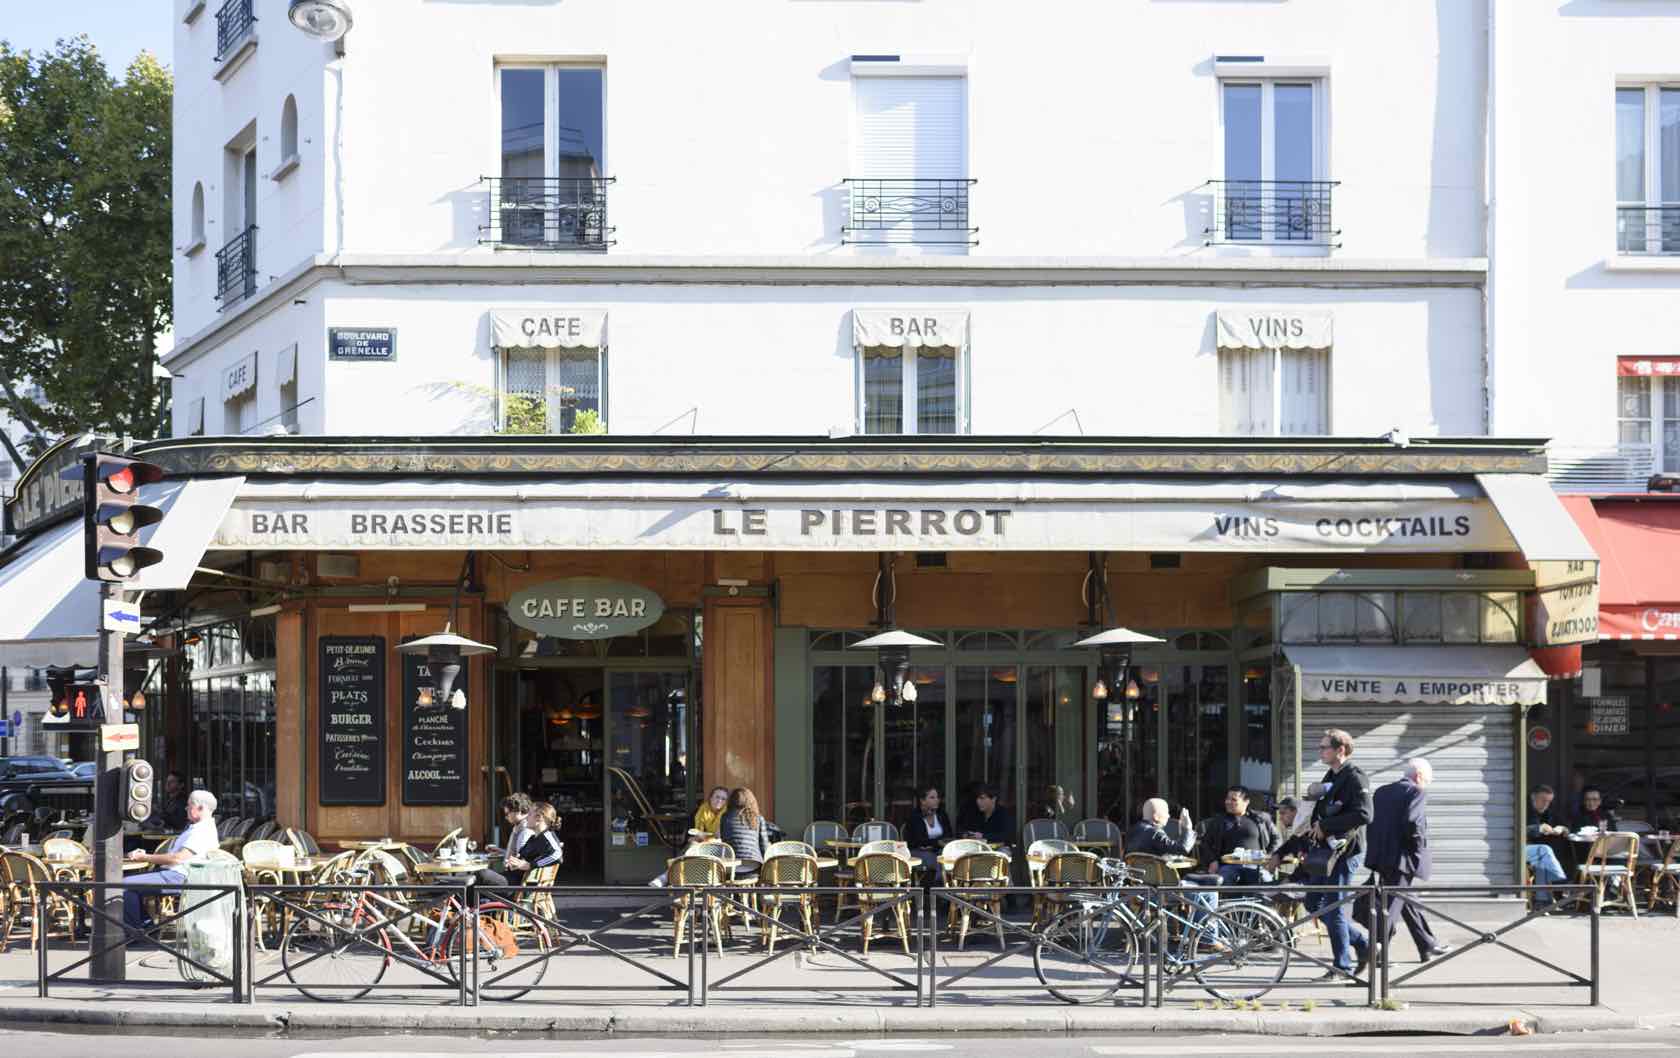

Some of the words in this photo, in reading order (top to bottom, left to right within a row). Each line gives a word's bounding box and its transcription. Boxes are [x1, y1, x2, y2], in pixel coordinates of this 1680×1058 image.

[336, 332, 389, 341] BOULEVARD
[521, 317, 581, 337] CAFE
[889, 317, 937, 337] BAR
[1248, 317, 1304, 337] VINS
[337, 346, 388, 355] GRENELLE
[228, 365, 247, 389] CAFE
[251, 513, 309, 535] BAR
[350, 513, 512, 535] BRASSERIE
[712, 509, 767, 536] LE
[800, 509, 1012, 536] PIERROT
[1214, 516, 1280, 537] VINS
[1315, 515, 1471, 537] COCKTAILS
[520, 597, 585, 617] CAFE
[594, 597, 647, 617] BAR
[331, 690, 368, 704] PLATS
[1320, 679, 1382, 694] VENTE
[1394, 681, 1408, 695] A
[1419, 681, 1520, 697] EMPORTER
[331, 713, 373, 725] BURGER
[418, 714, 449, 724] PLANCHE
